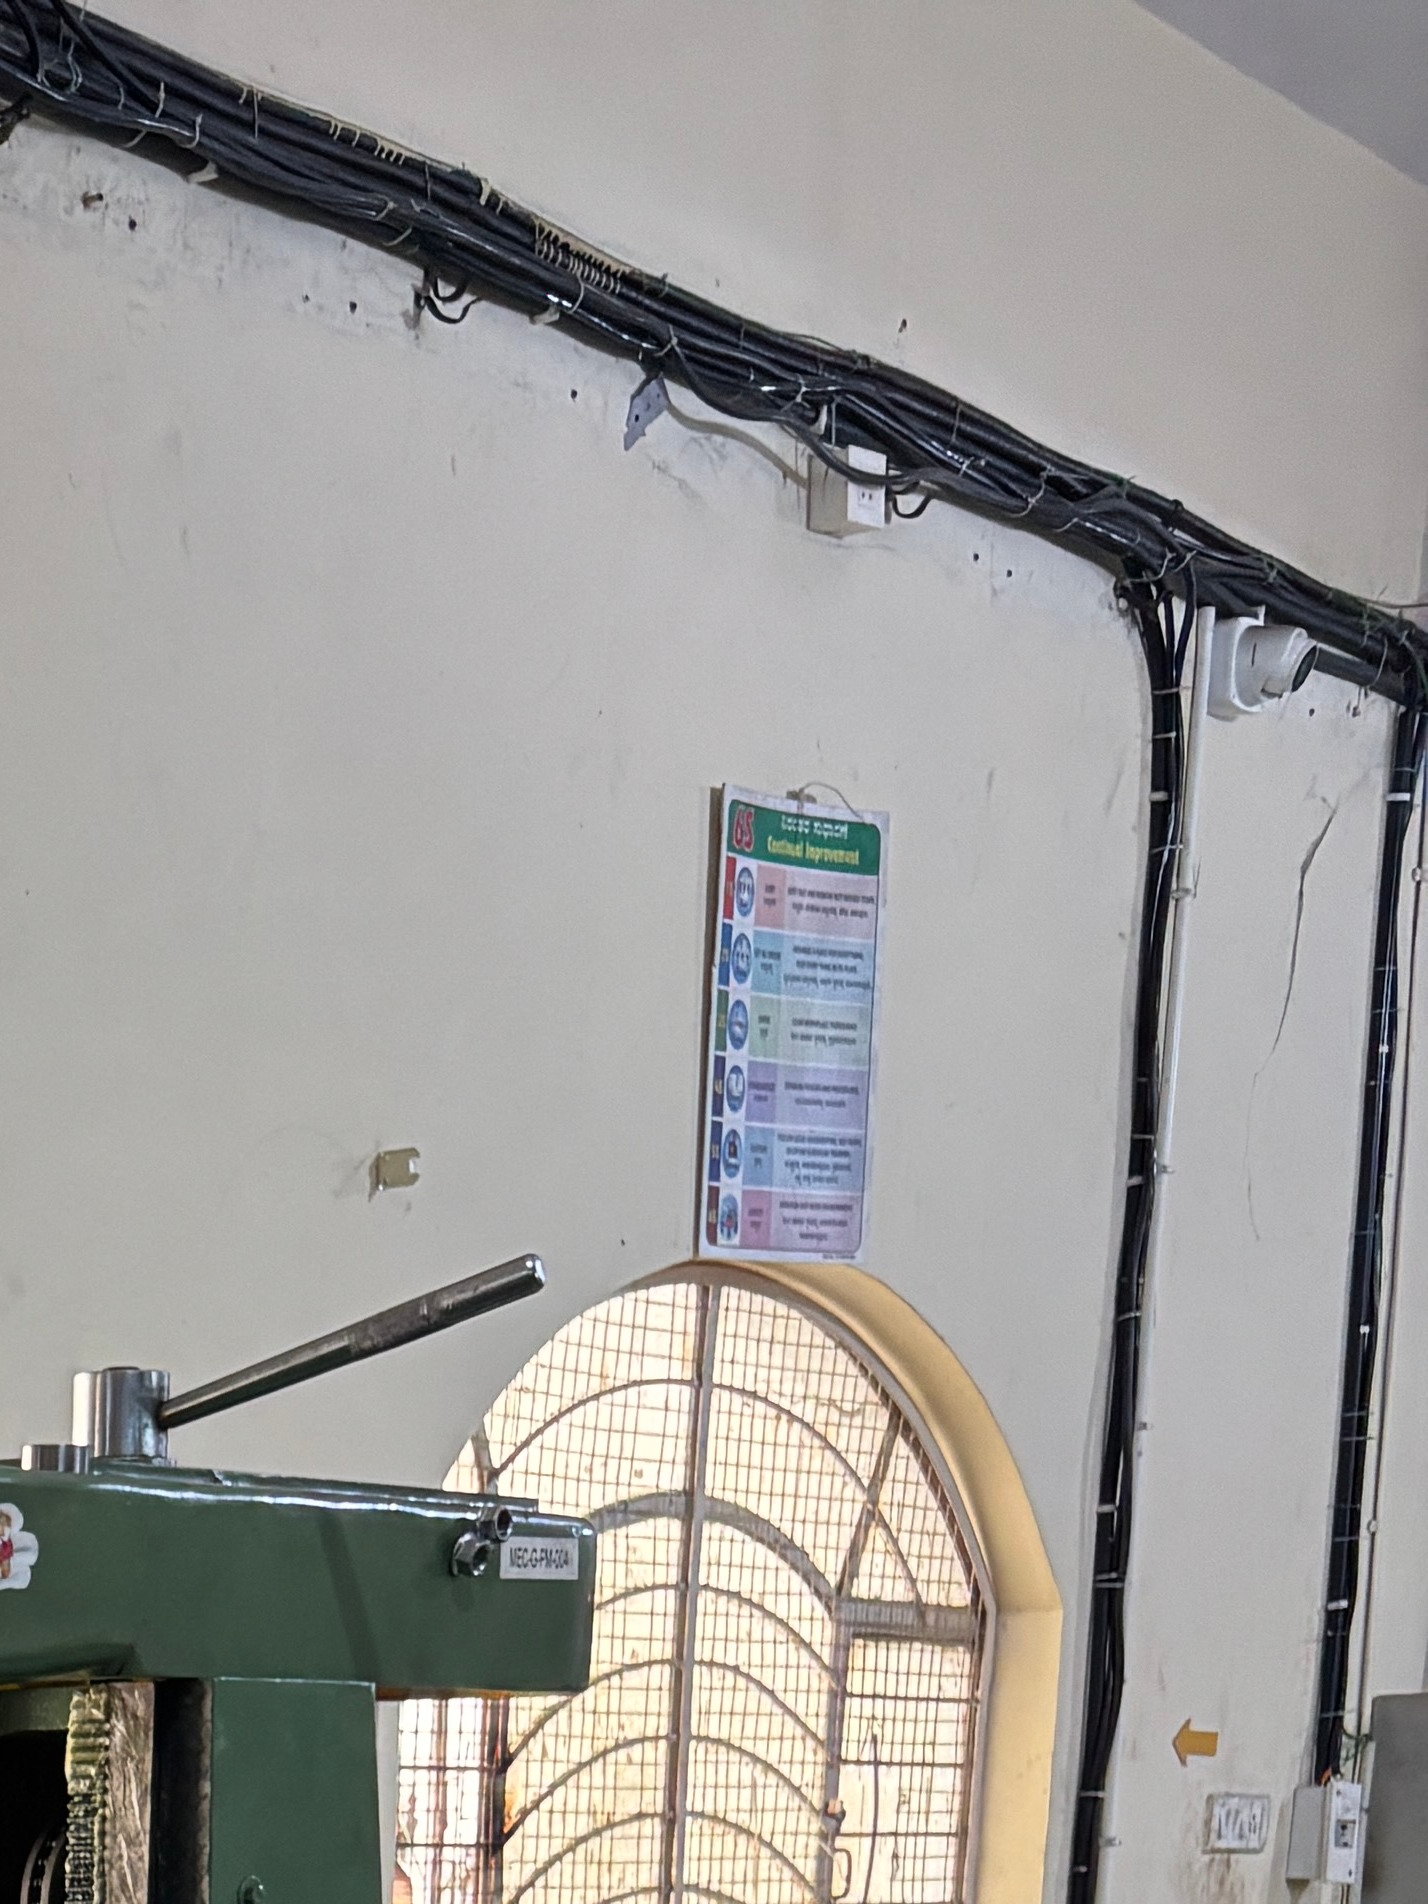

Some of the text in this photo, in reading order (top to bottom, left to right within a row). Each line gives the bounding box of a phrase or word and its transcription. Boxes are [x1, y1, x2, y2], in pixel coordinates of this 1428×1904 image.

[733, 805, 754, 852] 6S
[767, 835, 859, 865] Continual Improvement
